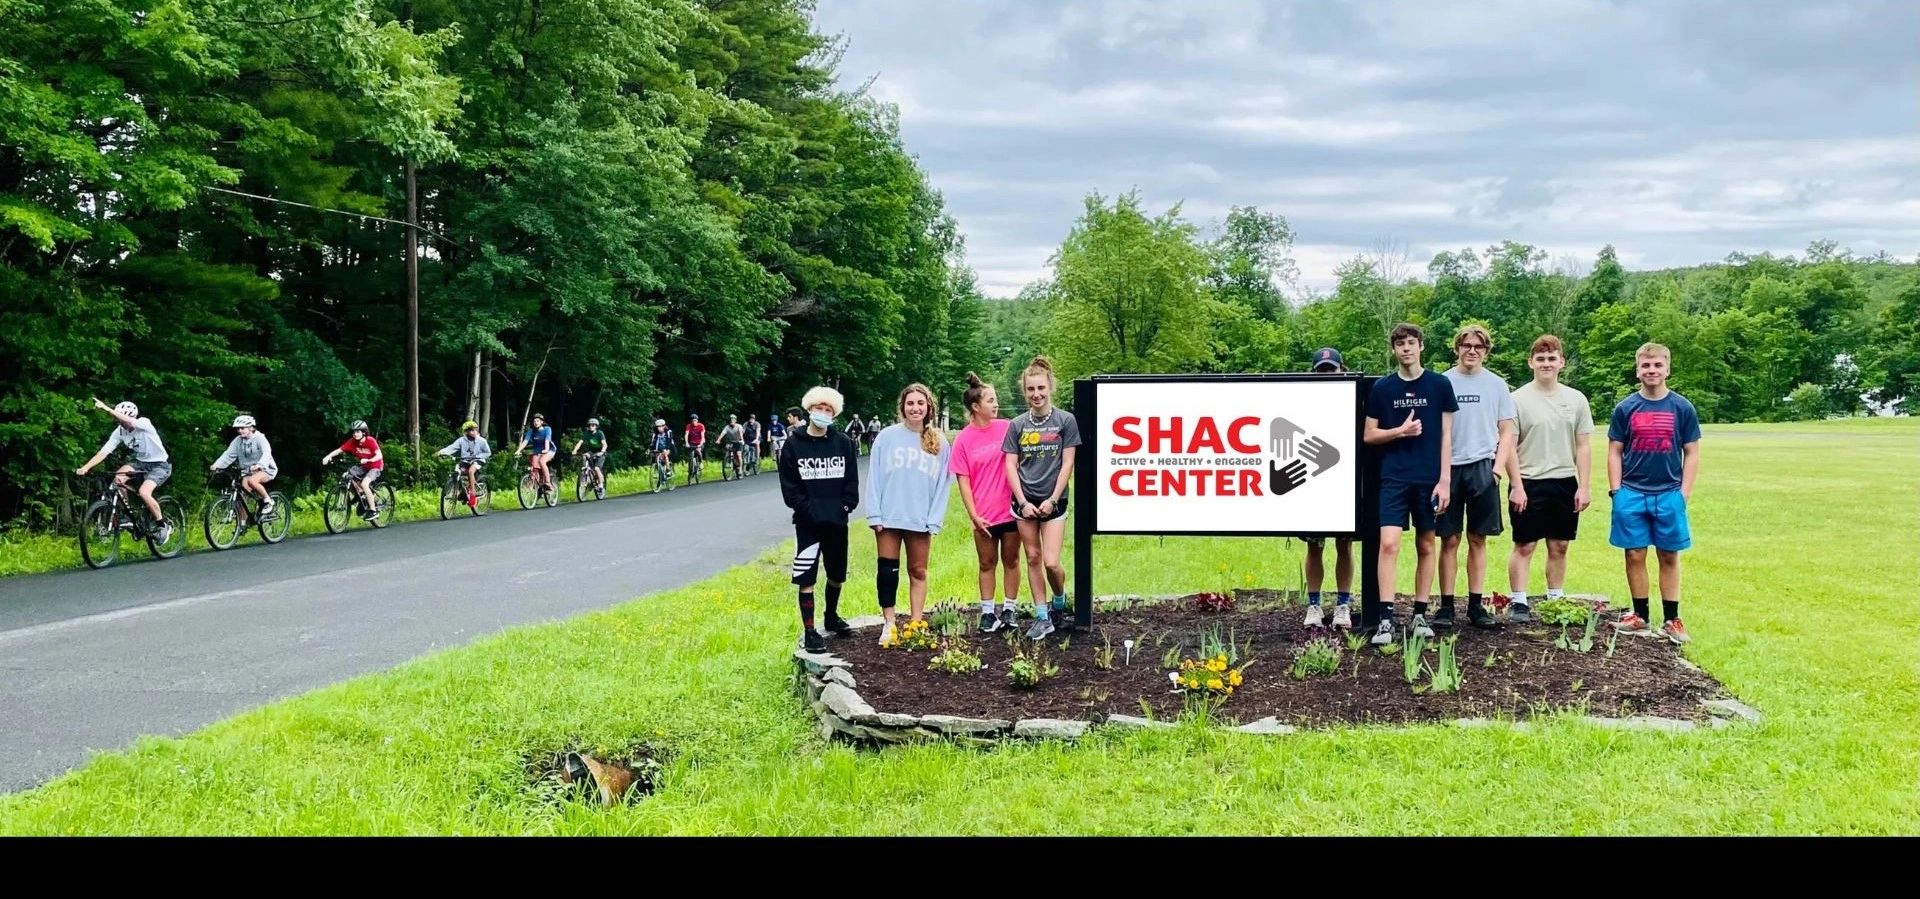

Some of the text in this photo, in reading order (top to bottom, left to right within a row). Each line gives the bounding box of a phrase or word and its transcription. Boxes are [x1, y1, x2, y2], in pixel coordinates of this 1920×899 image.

[1393, 398, 1428, 406] HILFIGER
[1111, 416, 1262, 454] SHAC
[1022, 444, 1059, 452] adventures
[797, 456, 845, 470] SKYHIGH
[1109, 469, 1264, 496] CENTER
